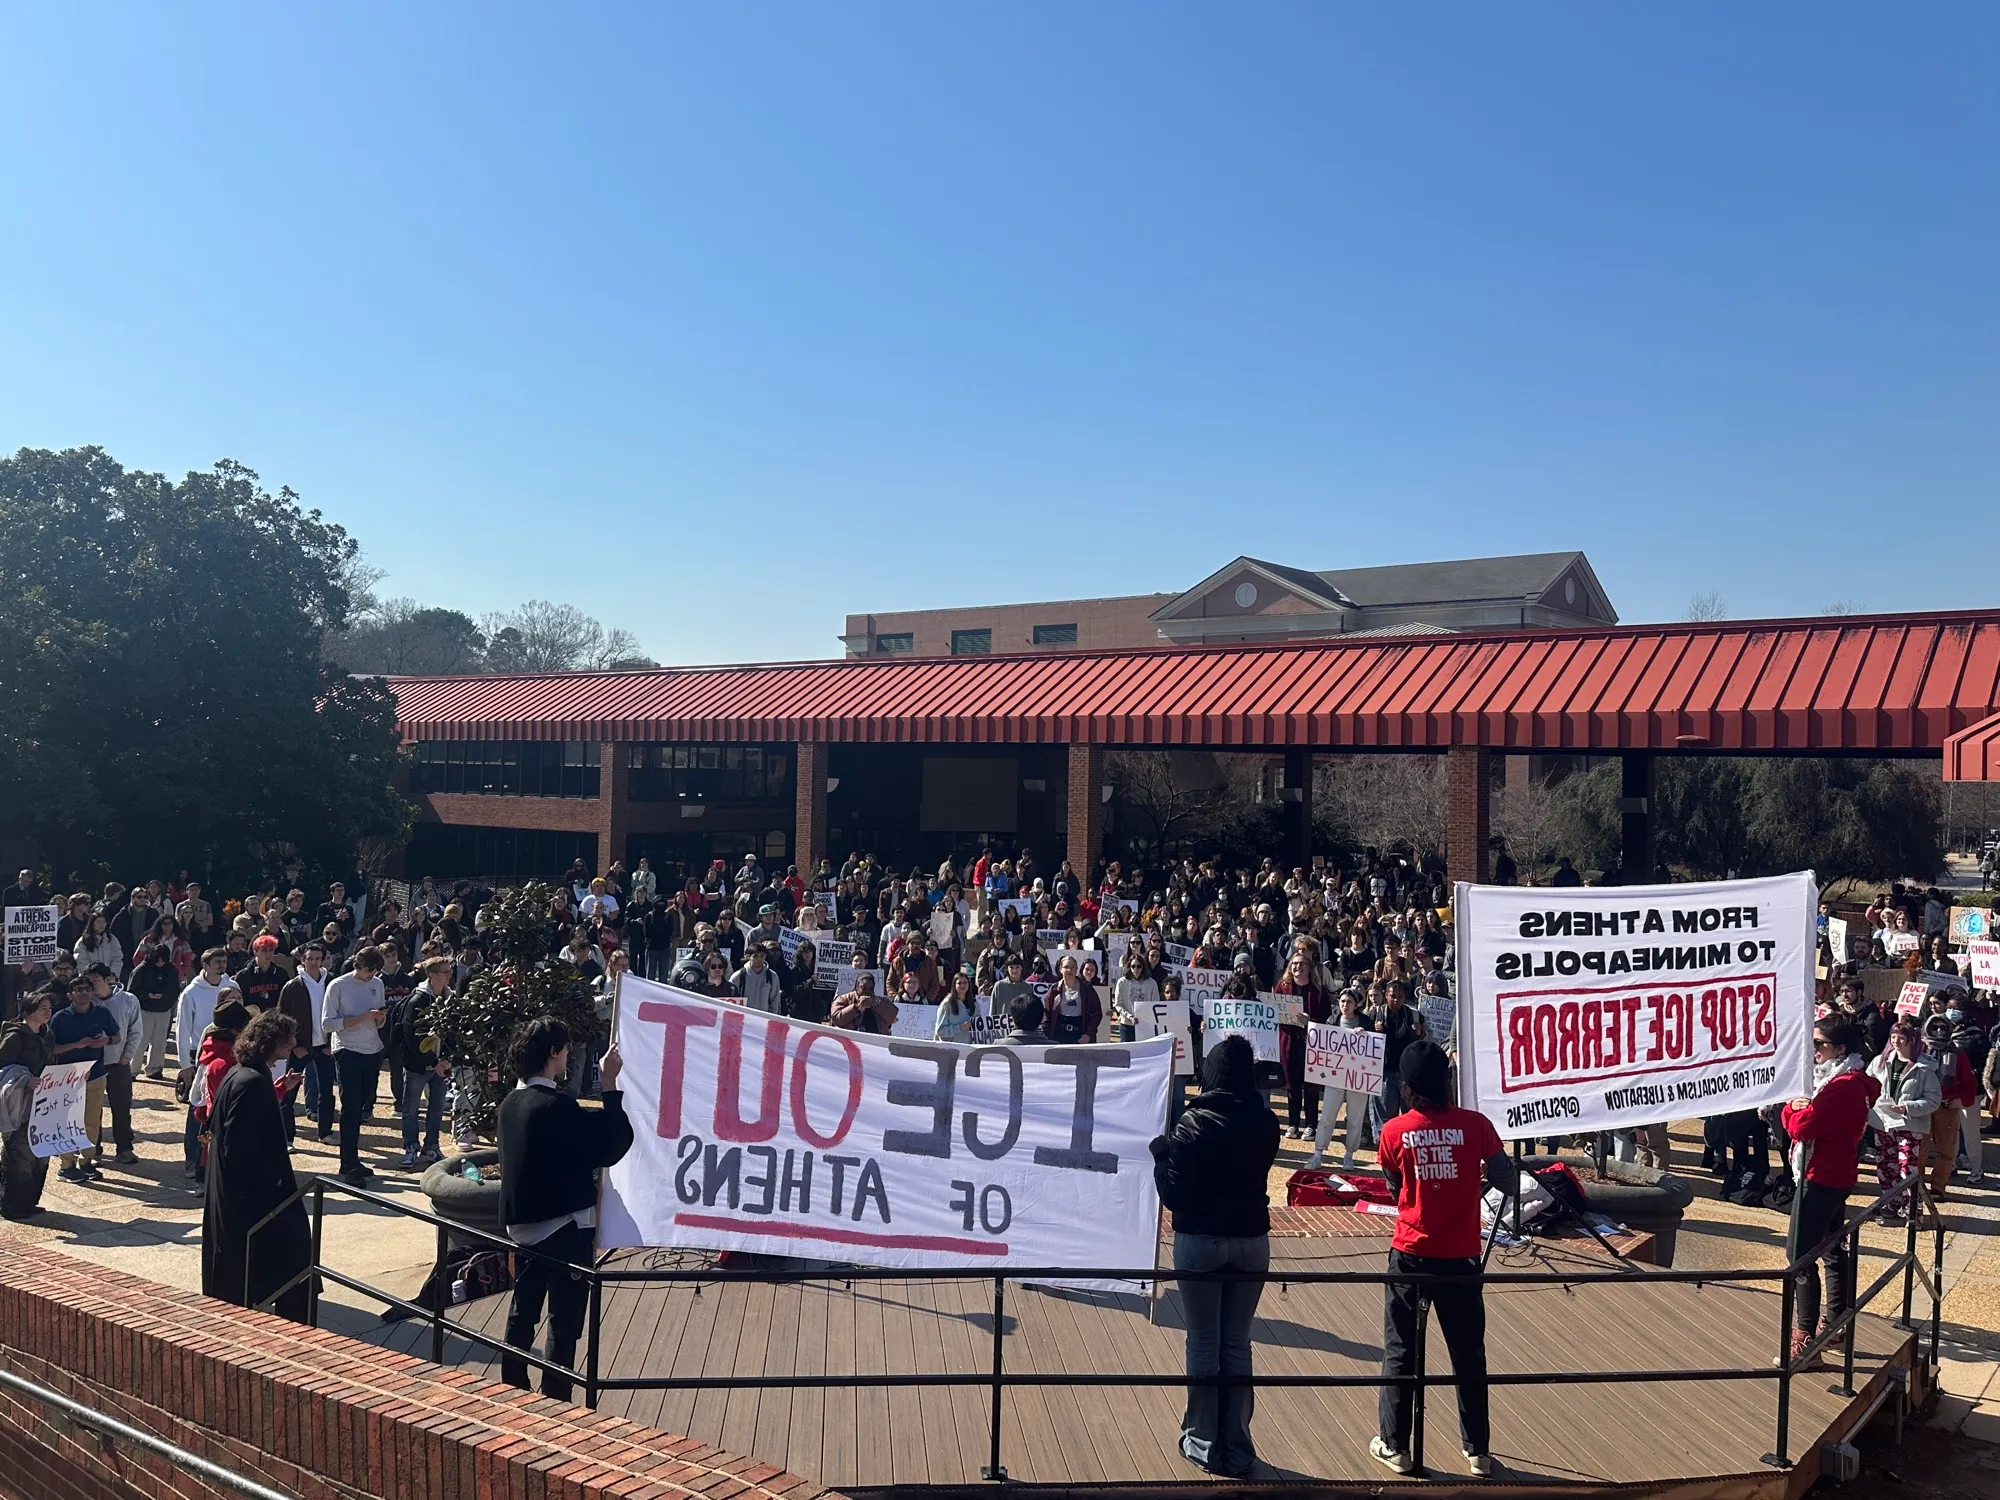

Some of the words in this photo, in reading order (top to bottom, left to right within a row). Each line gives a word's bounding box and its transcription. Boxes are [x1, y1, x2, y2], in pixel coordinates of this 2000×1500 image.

[14, 911, 51, 923] ATHENS
[8, 923, 55, 934] MINNEAPOLIS
[8, 936, 56, 945] STOP
[781, 930, 809, 943] RESTO
[1950, 935, 1969, 944] ABOLI
[8, 946, 21, 956] ICE
[23, 944, 56, 955] TERROR
[819, 949, 851, 960] UNITED
[1971, 945, 1998, 955] CHINGA
[817, 973, 838, 981] FAMILI
[1177, 971, 1229, 988] ABOLIS
[1974, 975, 1999, 986] MIGRA
[1904, 984, 1926, 992] FUCK
[1901, 993, 1921, 1004] ICE
[905, 1005, 924, 1015] ICE
[1214, 1003, 1275, 1018] DEFEND
[902, 1020, 918, 1028] OUR
[969, 1016, 984, 1031] NO
[986, 1014, 1015, 1030] DECE
[1208, 1018, 1278, 1031] DEMOCRACY
[1308, 1028, 1384, 1060] OLIGARGLE
[1306, 1049, 1345, 1069] DEEZ
[36, 1072, 65, 1095] Stand
[1345, 1069, 1382, 1094] NUTZ
[34, 1097, 58, 1117] Fight
[29, 1123, 65, 1146] Break
[66, 1120, 86, 1137] the
[1402, 1129, 1464, 1149] SOCIALISM
[1416, 1148, 1428, 1164] IS
[1430, 1146, 1453, 1163] THE
[1414, 1163, 1458, 1180] FUTURE
